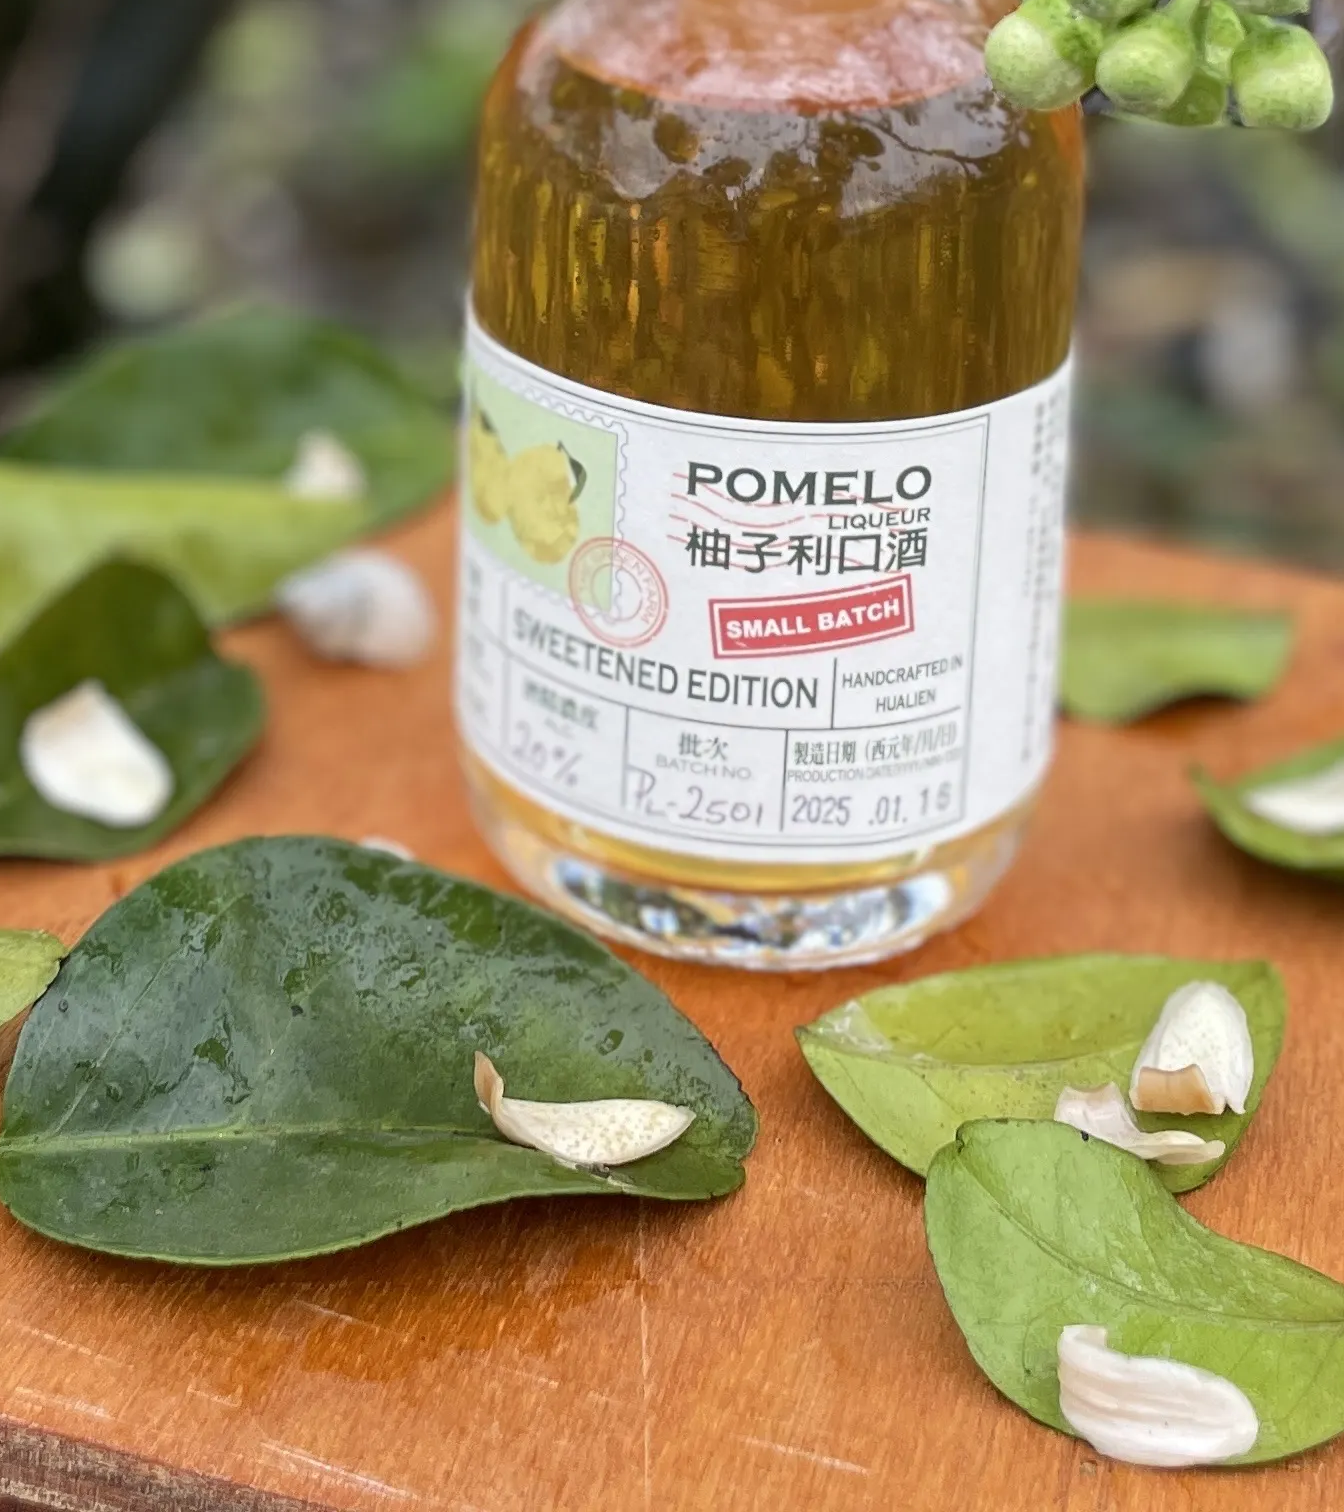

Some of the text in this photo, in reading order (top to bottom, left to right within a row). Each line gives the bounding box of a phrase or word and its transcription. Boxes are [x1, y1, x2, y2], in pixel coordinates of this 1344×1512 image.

[687, 461, 932, 505] POMELO
[828, 507, 931, 530] LIQUEUR
[685, 525, 928, 575] 柚子利口酒
[726, 597, 900, 639] SMALL BATCH
[513, 607, 679, 695] SWEETENED
[687, 668, 819, 708] EDITION
[842, 659, 949, 688] HANDCRAFTED
[875, 689, 937, 713] HUALIEN
[679, 732, 728, 760] 批次
[656, 754, 717, 777] BATCH
[787, 768, 865, 783] PRODUCTION
[792, 794, 852, 826] 2025
